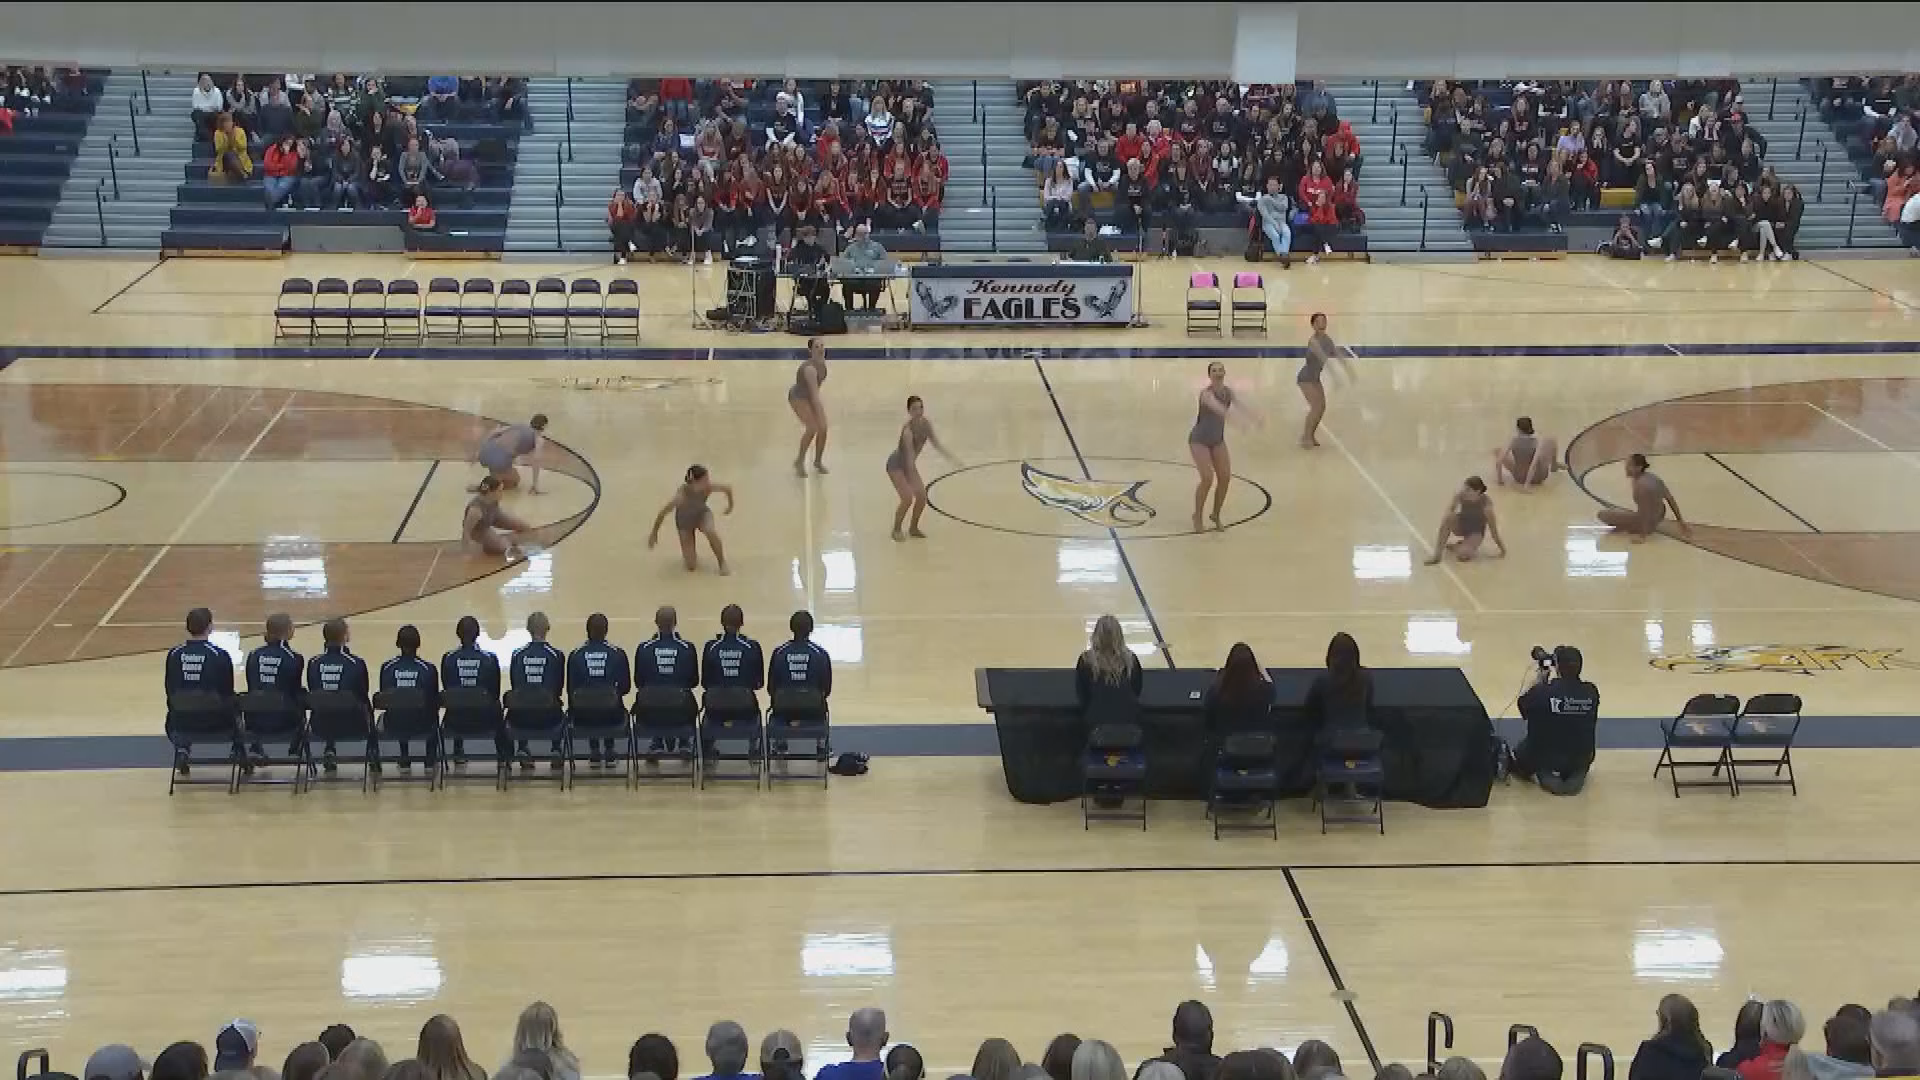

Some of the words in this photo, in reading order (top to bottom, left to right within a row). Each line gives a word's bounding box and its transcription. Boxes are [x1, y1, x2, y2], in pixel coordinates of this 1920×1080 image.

[966, 280, 1076, 296] Kennedy
[964, 298, 1081, 320] EAGLES
[585, 652, 608, 660] Century
[654, 648, 677, 656] Century
[719, 650, 742, 659] Century
[181, 654, 205, 662] Century
[259, 656, 281, 666] Century
[523, 656, 546, 665] Century
[787, 654, 809, 662] Century
[457, 658, 480, 668] Century
[260, 665, 278, 674] Dance
[320, 664, 343, 672] Century
[459, 668, 478, 676] Dance
[525, 666, 544, 674] Dance
[589, 668, 604, 676] Team
[724, 668, 738, 676] Team
[184, 672, 200, 680] Team
[260, 674, 275, 682] Team
[395, 670, 418, 678] Century
[791, 672, 806, 680] Team
[397, 679, 416, 687] Dance
[460, 677, 476, 686] Team
[322, 682, 338, 690] Team
